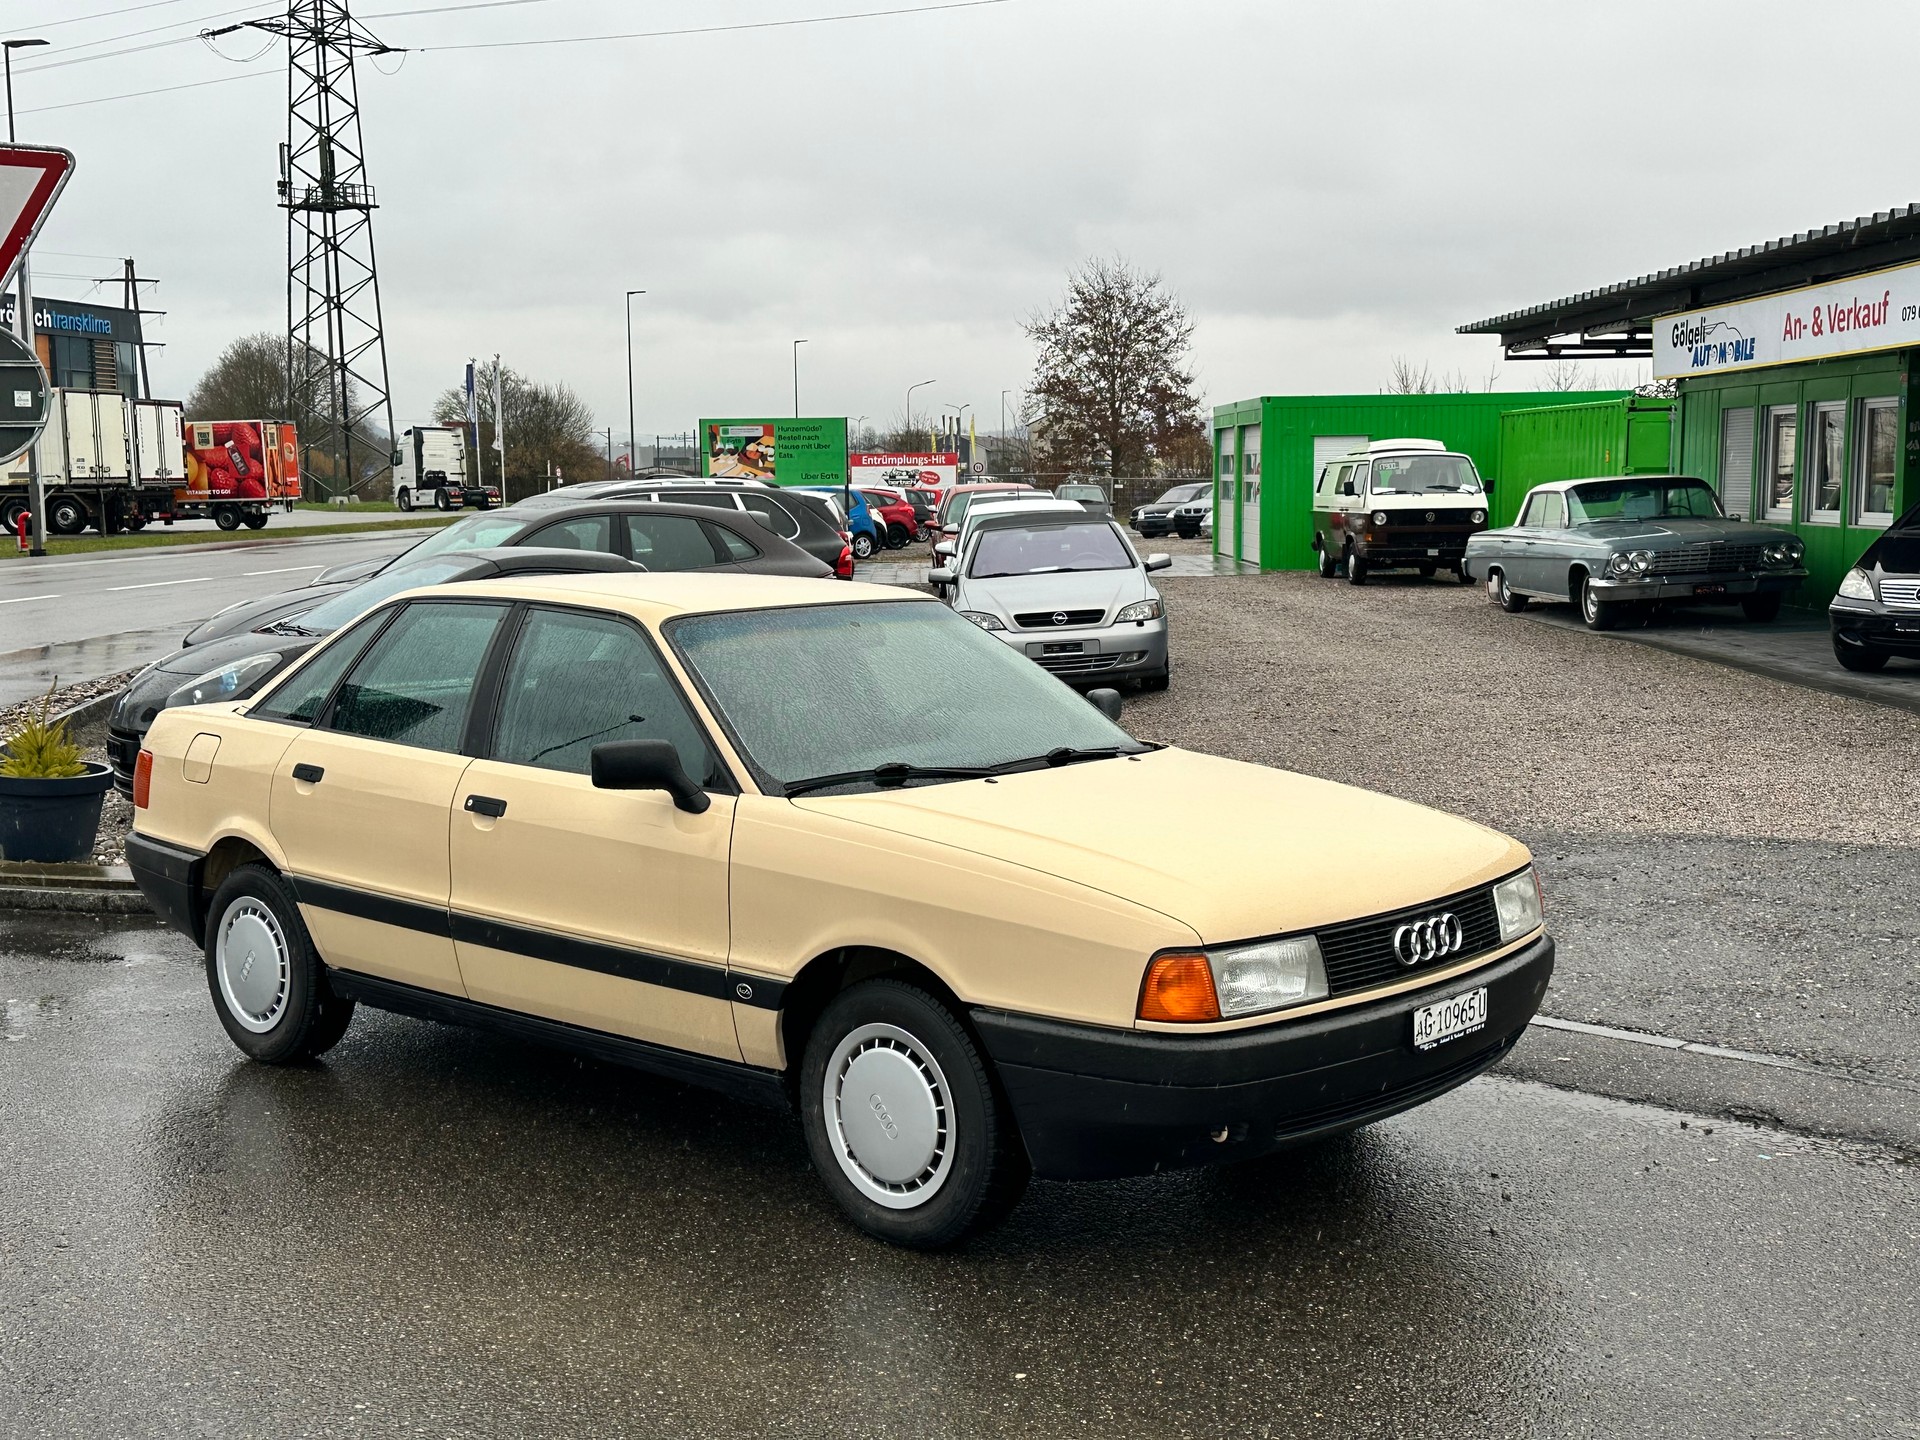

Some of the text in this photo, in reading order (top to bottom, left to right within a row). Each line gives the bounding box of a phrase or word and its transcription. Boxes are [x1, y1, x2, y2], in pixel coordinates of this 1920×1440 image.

[1783, 312, 1807, 342] An-
[1812, 305, 1823, 337] &
[1827, 290, 1890, 334] Verkauf
[1901, 304, 1917, 322] 079
[1672, 316, 1706, 353] Gölgeli
[1691, 337, 1756, 368] AUTOMOBILE
[801, 442, 813, 450] mit
[861, 454, 946, 466] Entrümplungs-Hit
